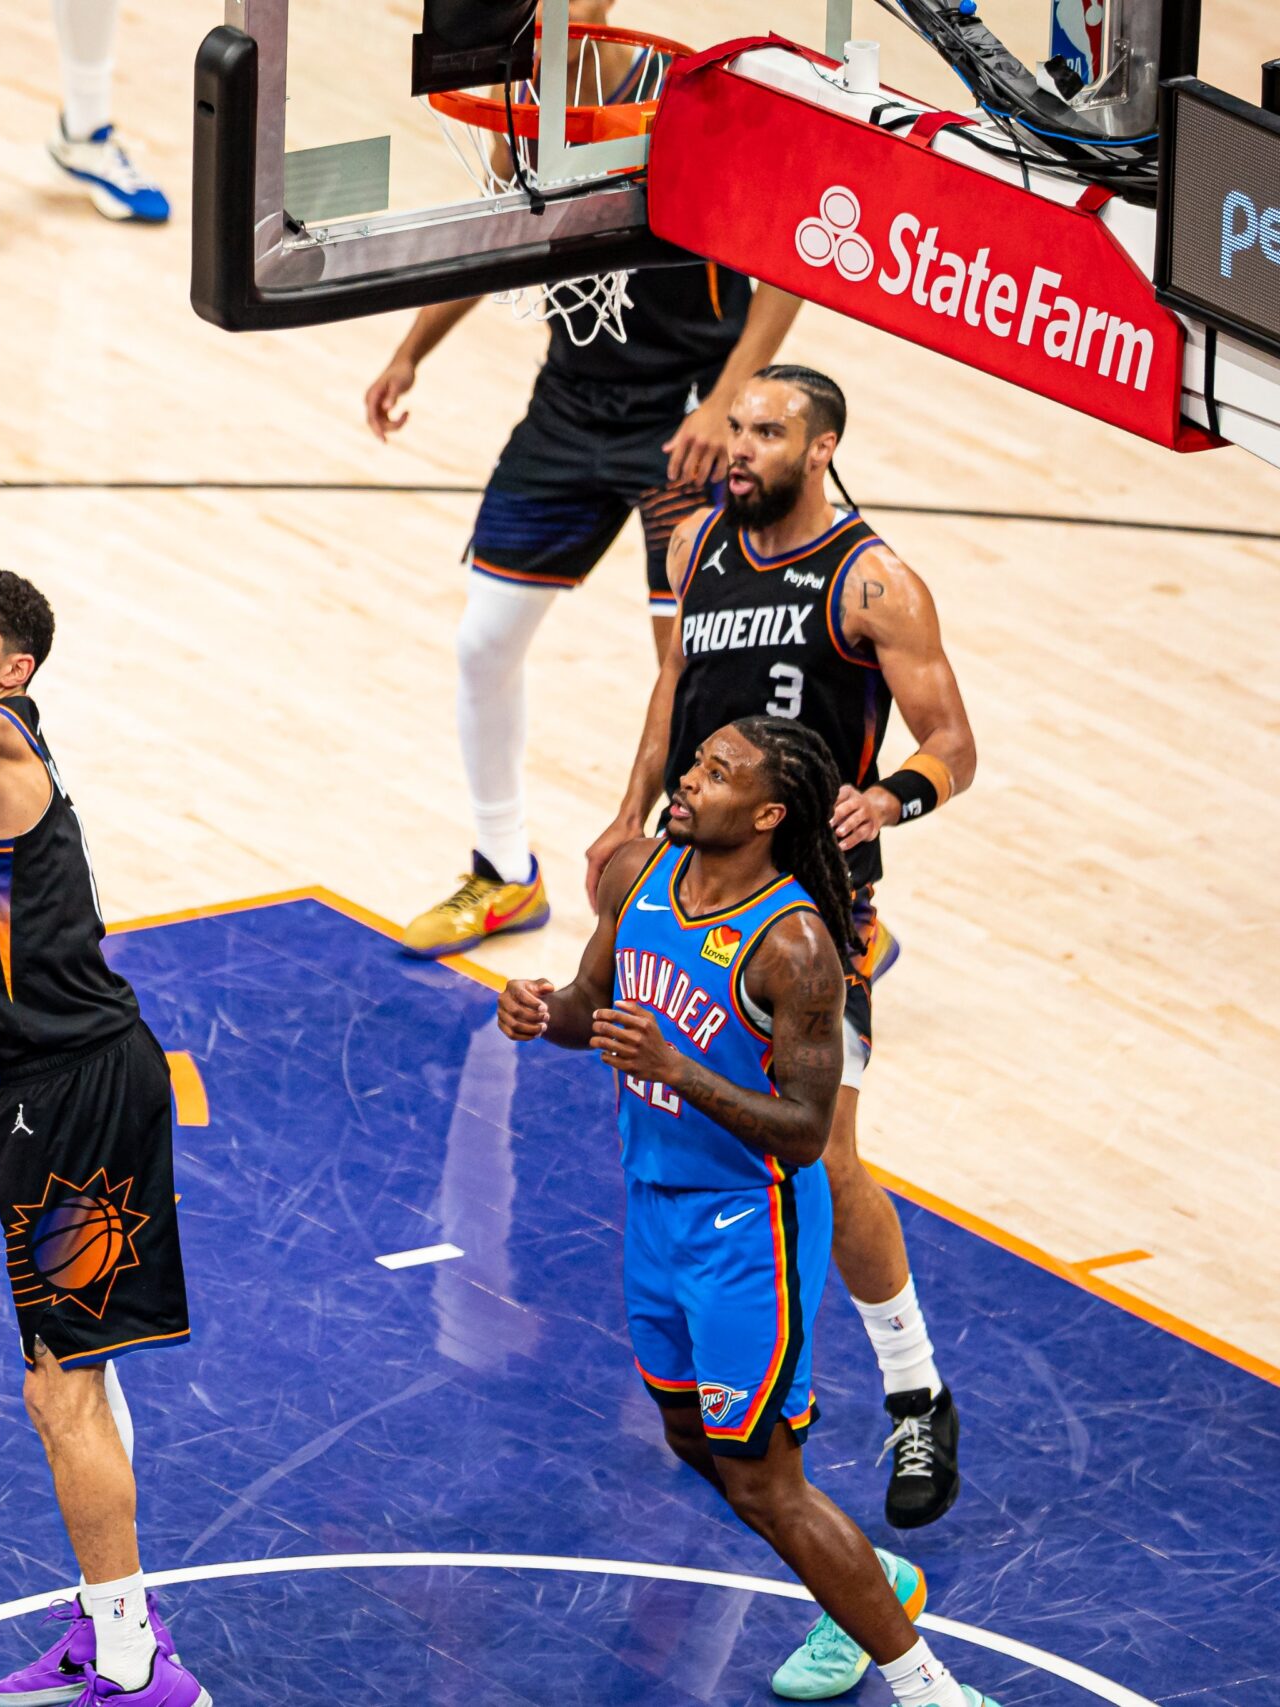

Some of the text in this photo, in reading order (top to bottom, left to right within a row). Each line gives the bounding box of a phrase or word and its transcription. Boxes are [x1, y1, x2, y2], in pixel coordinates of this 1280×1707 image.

[783, 568, 826, 590] PayPal
[682, 603, 814, 656] PHOENIX
[765, 661, 805, 720] 3
